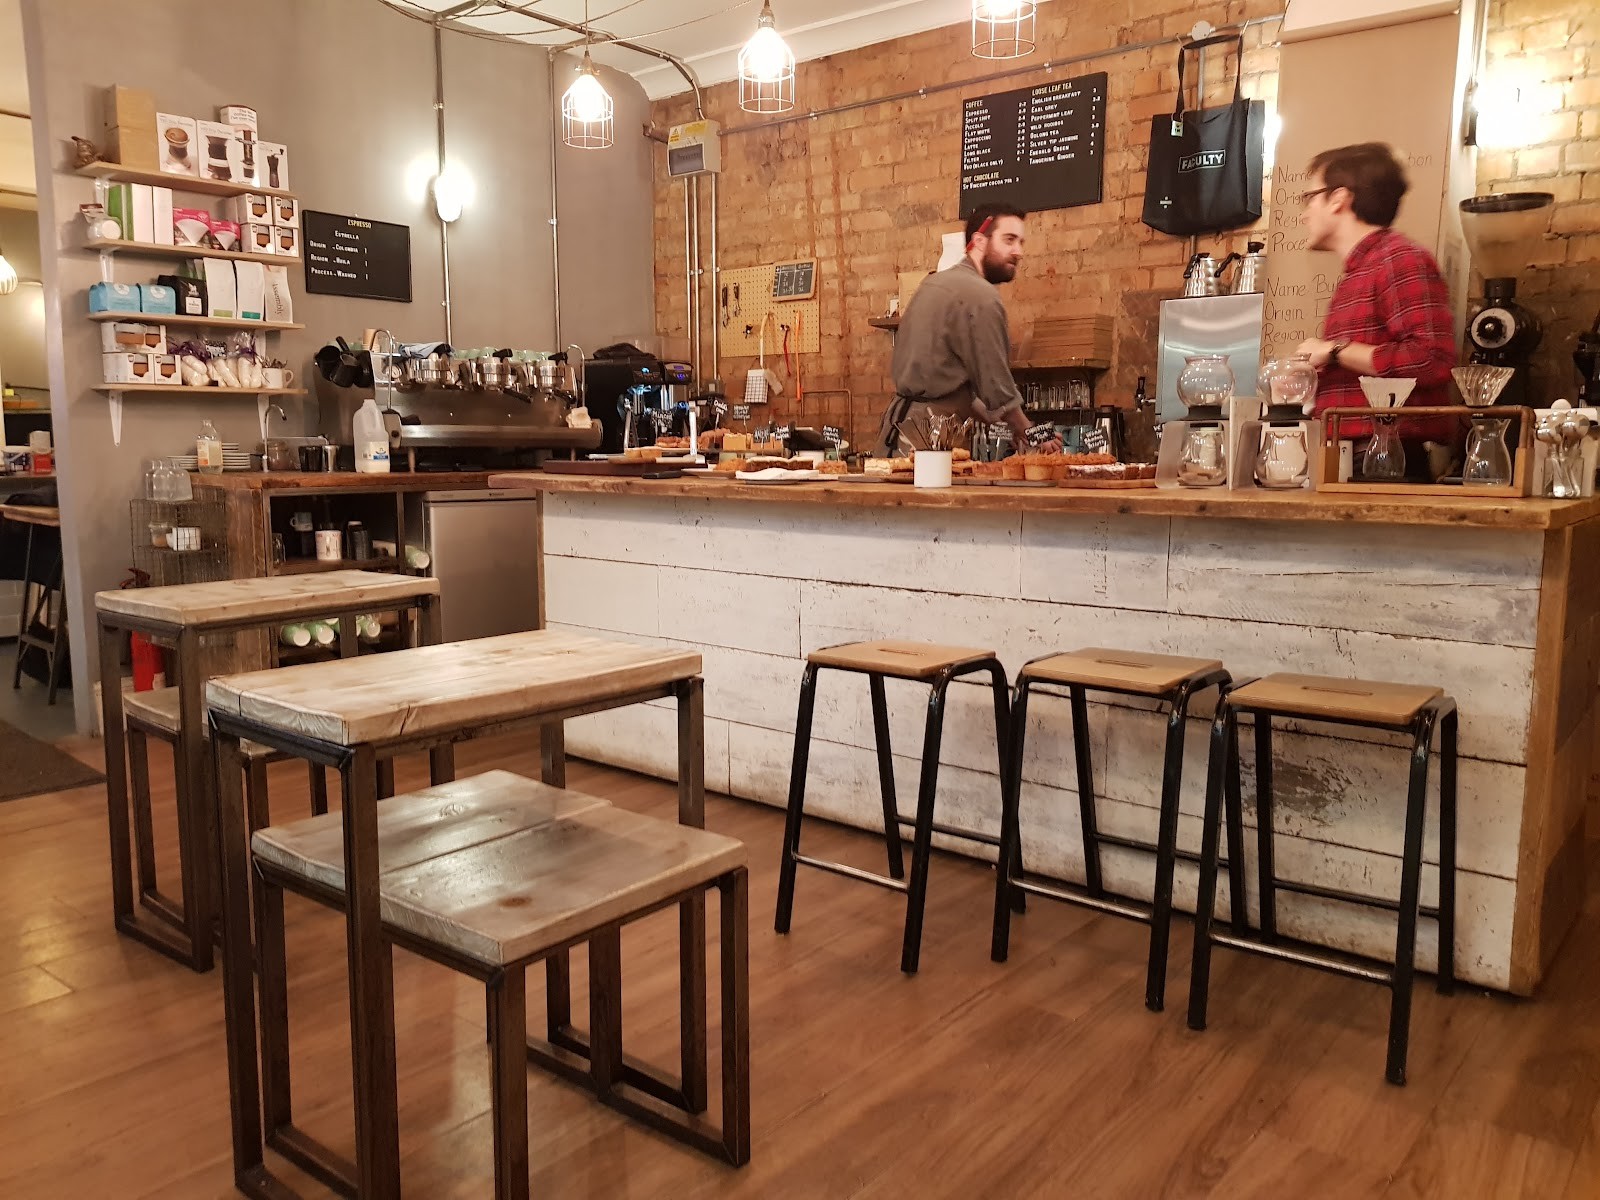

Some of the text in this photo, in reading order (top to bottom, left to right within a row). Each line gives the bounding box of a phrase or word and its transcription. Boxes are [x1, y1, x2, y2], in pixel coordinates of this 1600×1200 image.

[1032, 87, 1047, 96] LOOSE
[1049, 84, 1061, 93] LEAF
[966, 100, 983, 108] COFFEE
[1182, 154, 1223, 169] FACULTY
[1278, 164, 1312, 184] Name
[1276, 188, 1304, 205] Origi
[347, 219, 372, 228] ESPRESSO
[1266, 276, 1306, 297] Name
[1265, 300, 1304, 321] Origin
[1262, 322, 1306, 344] Region
